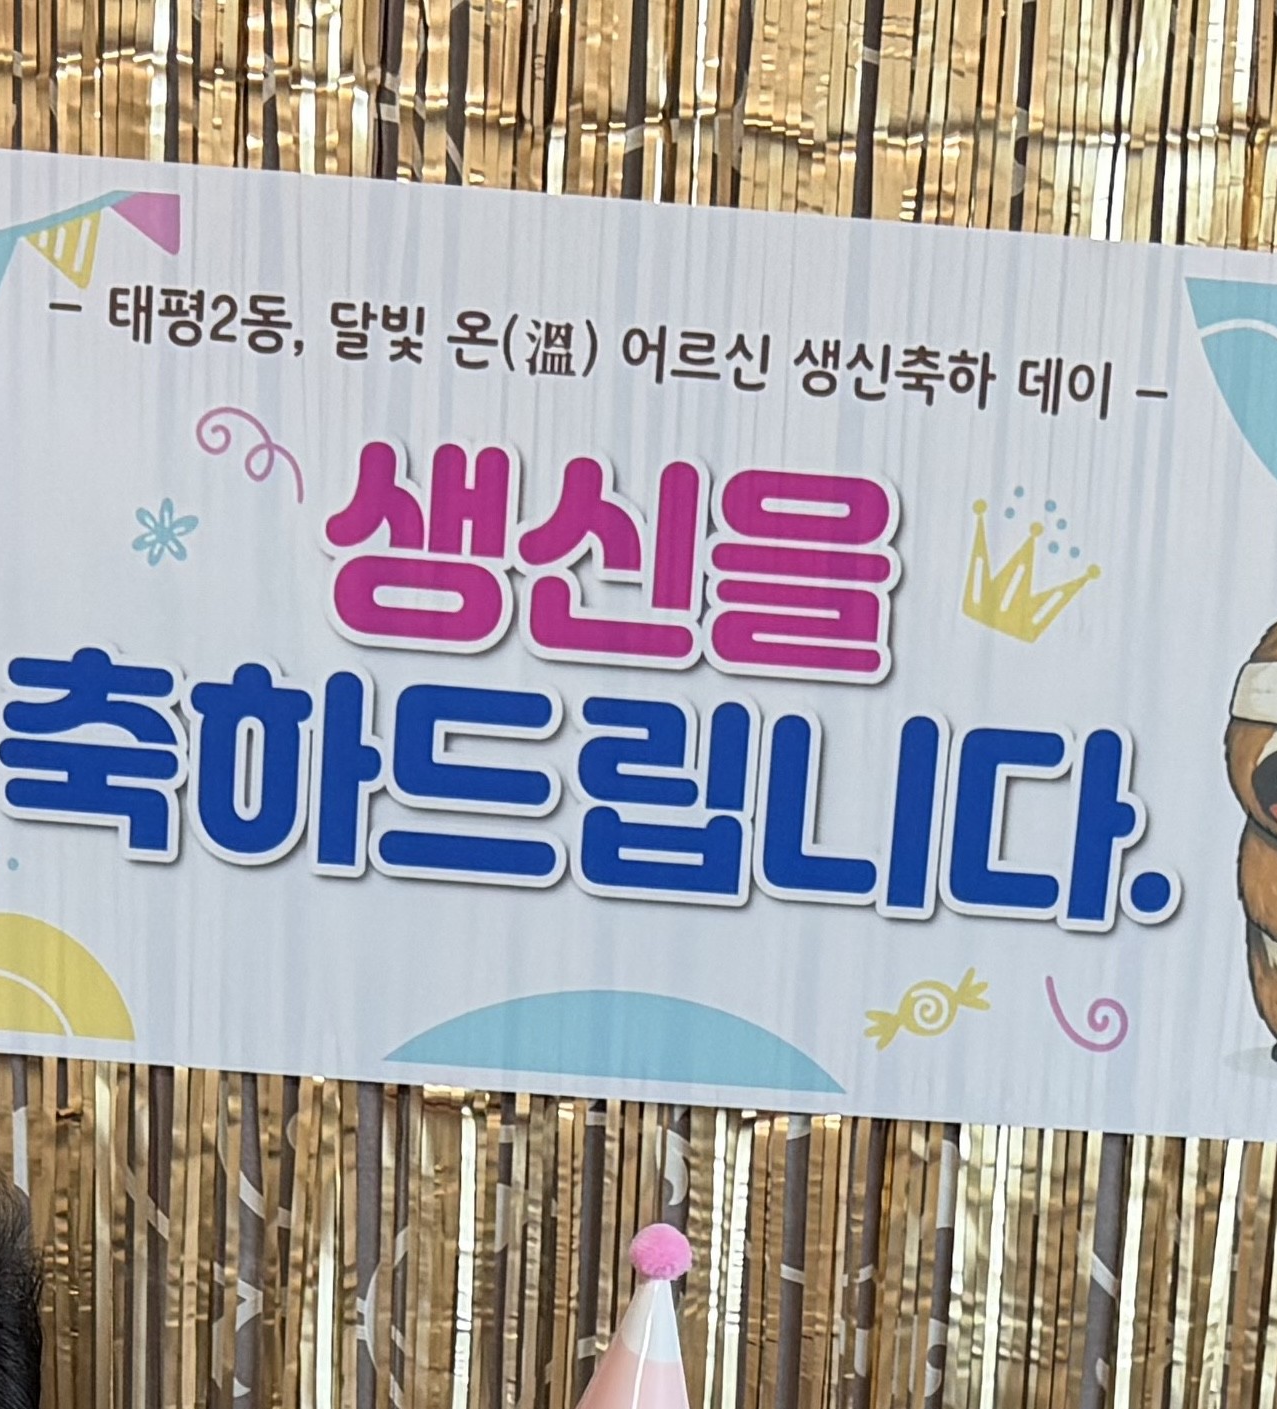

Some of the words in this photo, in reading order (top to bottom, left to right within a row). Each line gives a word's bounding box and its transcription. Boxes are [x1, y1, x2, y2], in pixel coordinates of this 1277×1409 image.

[109, 285, 304, 357] 태평2동,
[330, 301, 425, 364] 달빛
[622, 325, 770, 391] 어르신
[793, 339, 997, 410] 생신축하
[1018, 357, 1112, 420] 데이
[324, 441, 892, 673] 생신을
